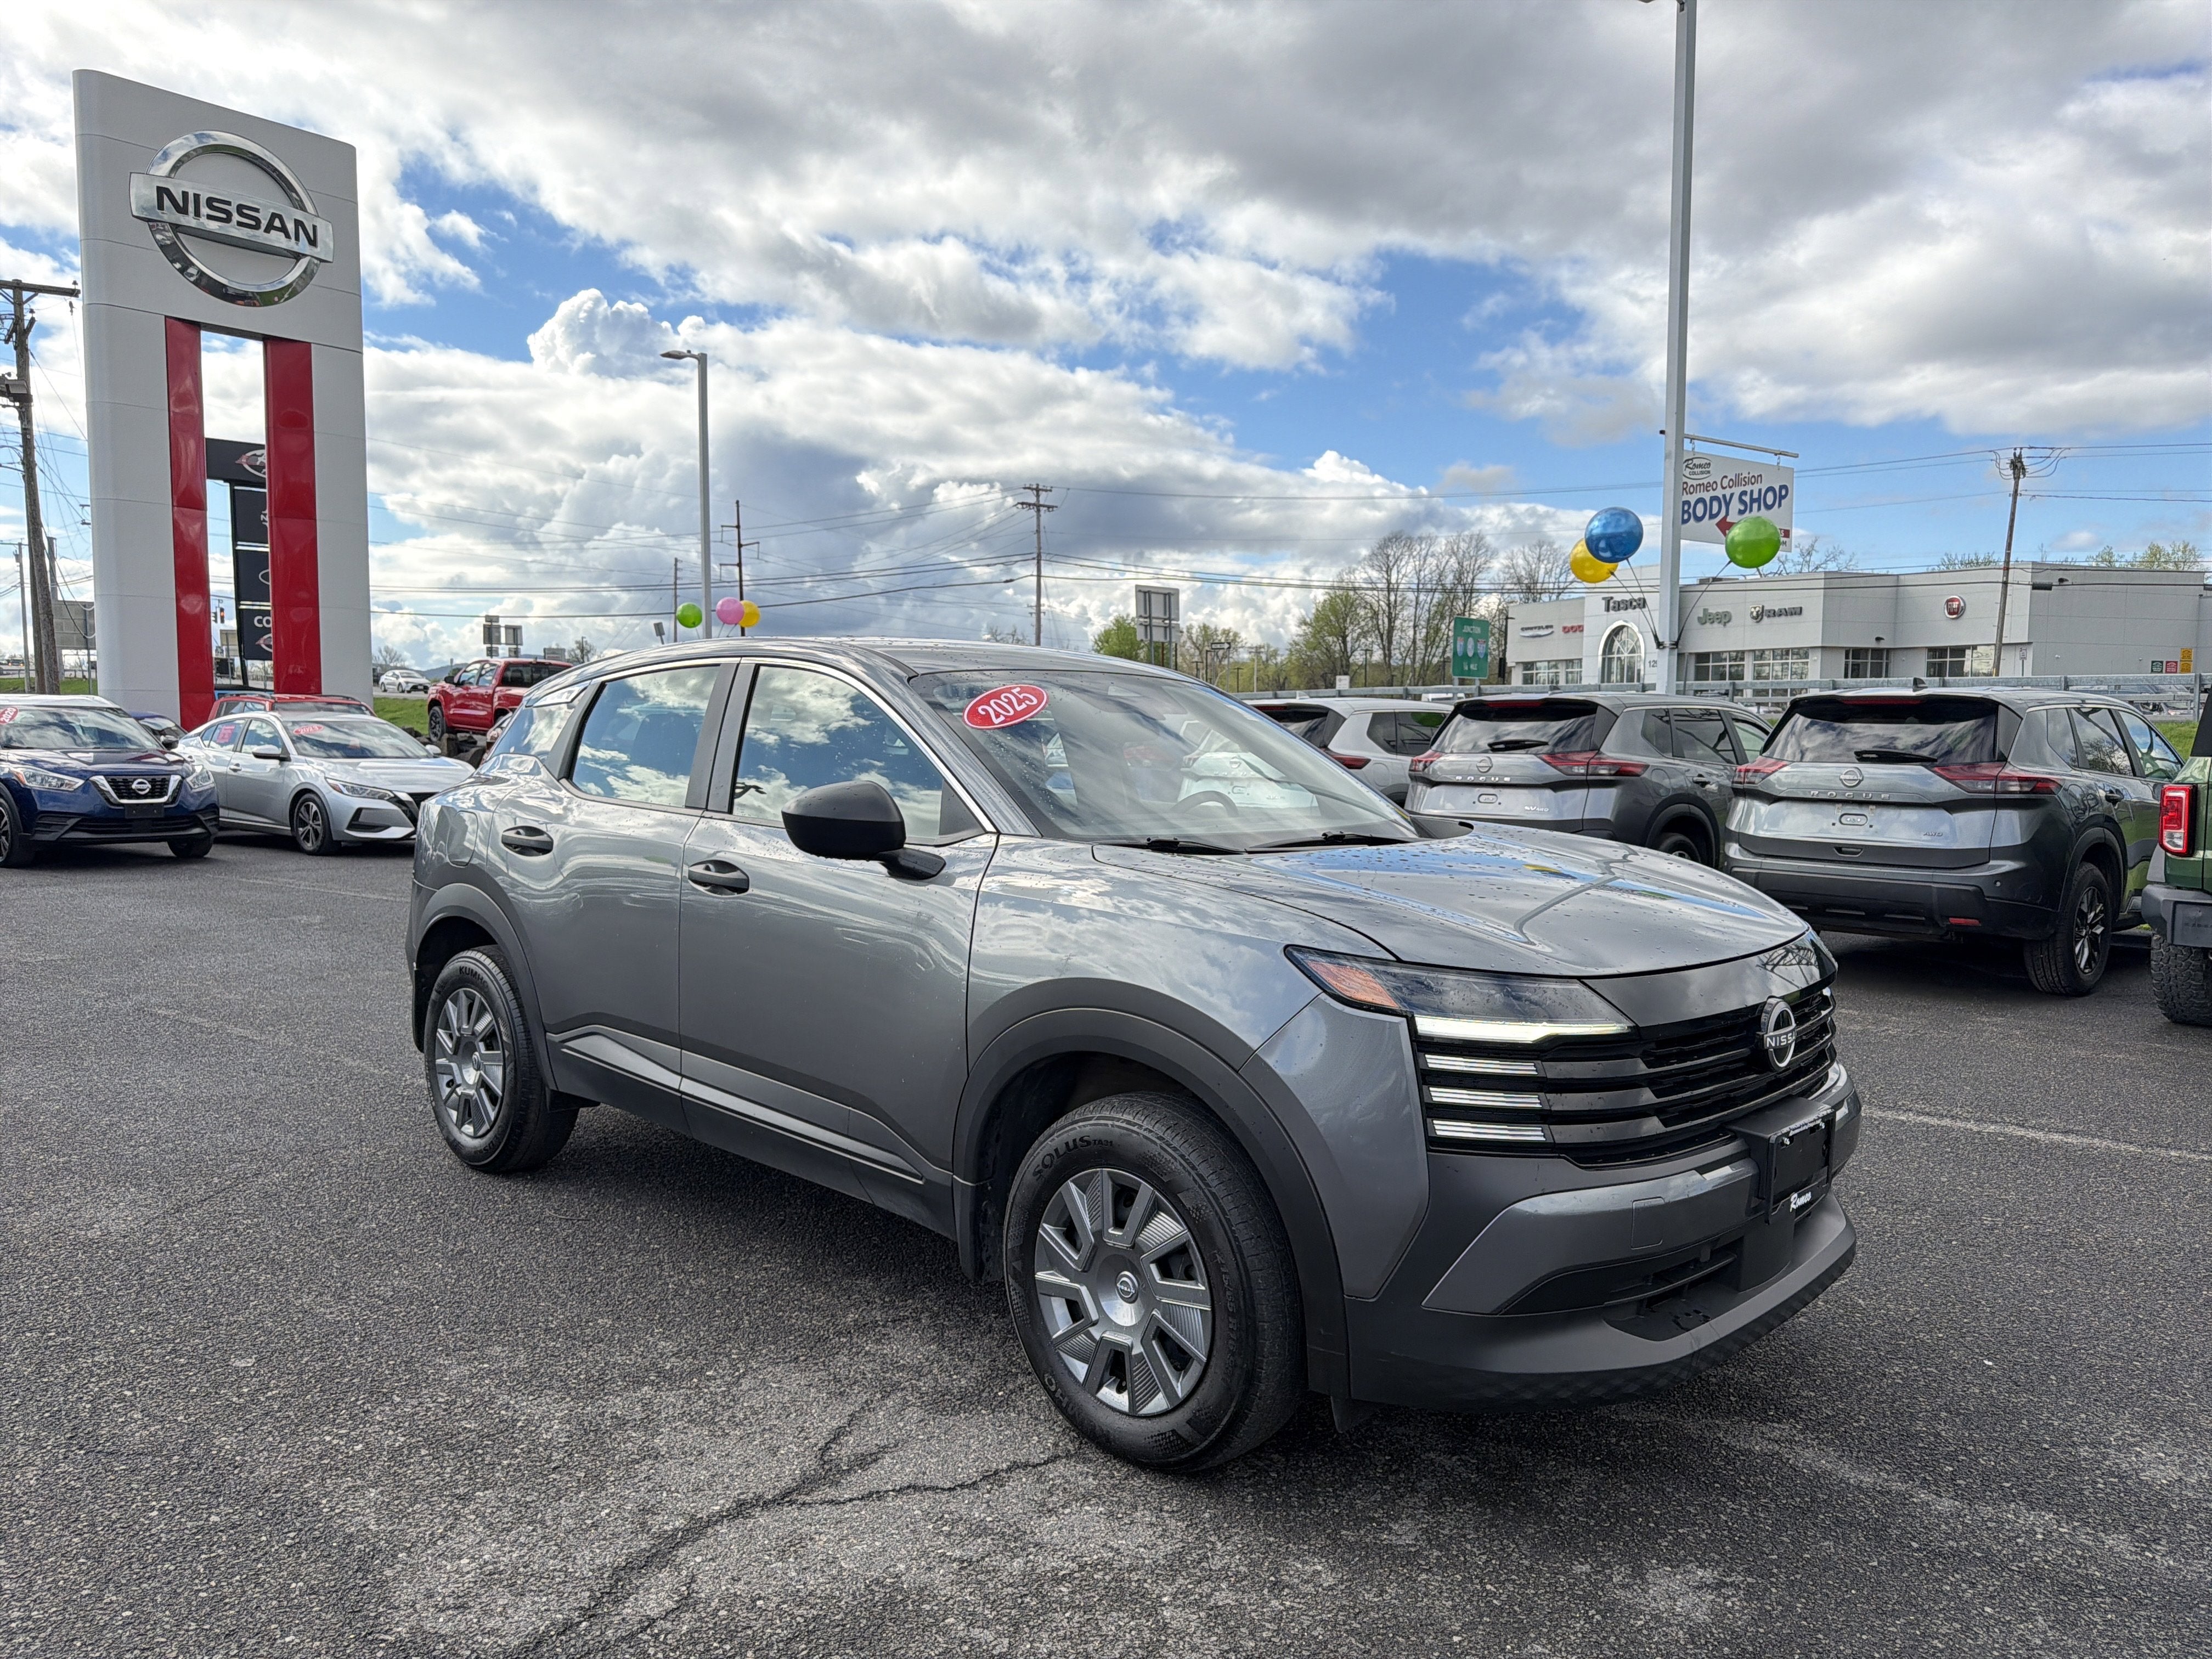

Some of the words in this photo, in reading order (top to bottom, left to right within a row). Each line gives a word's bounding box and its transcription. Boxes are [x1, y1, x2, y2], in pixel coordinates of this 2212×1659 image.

[155, 185, 319, 248] NISSAN
[1683, 458, 1711, 471] Romeo
[1682, 478, 1718, 496] Romeo
[1720, 472, 1763, 490] Collision
[1681, 492, 1735, 525] BODY
[1737, 484, 1789, 516] SHOP
[1601, 596, 1646, 612] Tasca
[1764, 606, 1803, 618] RAM
[1697, 608, 1732, 627] Jeep
[978, 686, 1038, 724] 2025
[1, 707, 17, 723] 2020
[1810, 790, 1891, 800] ROGUE
[459, 966, 489, 989] KUMHO
[1767, 1030, 1797, 1047] NISSA
[1032, 1135, 1092, 1182] SOLUS
